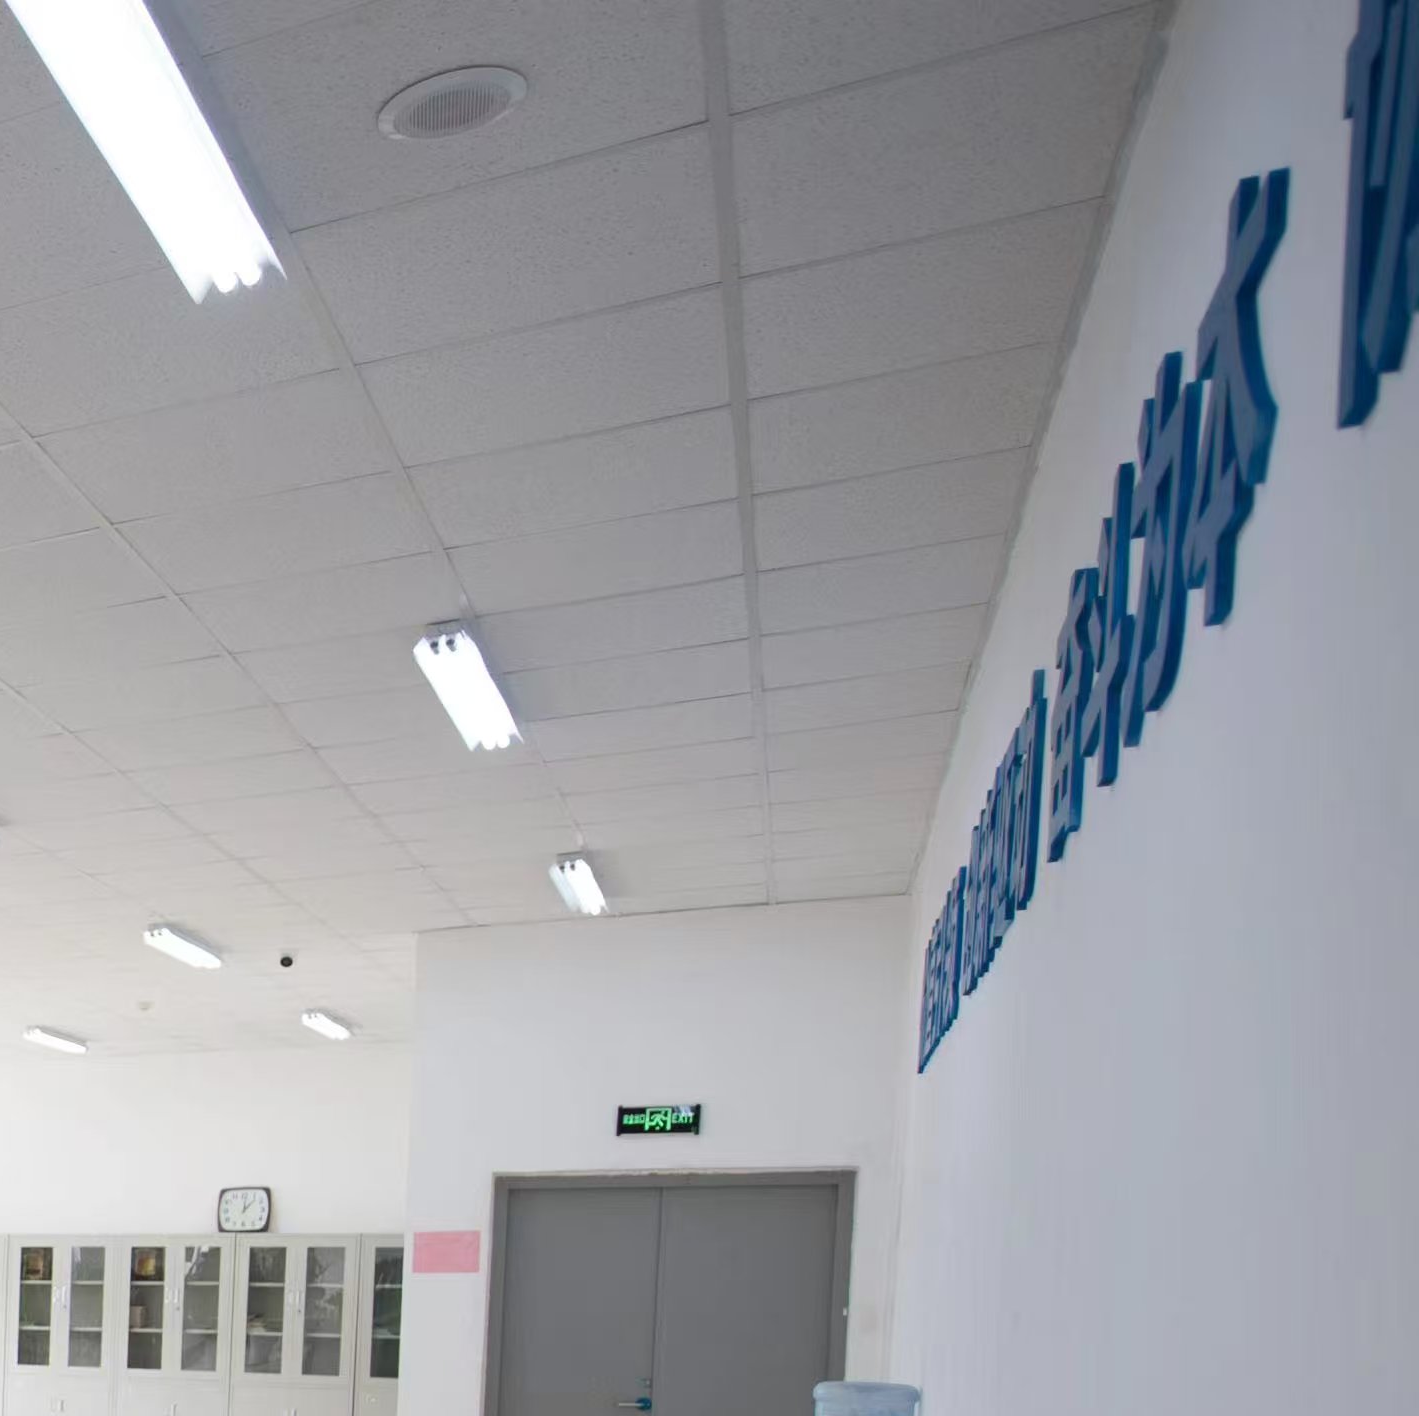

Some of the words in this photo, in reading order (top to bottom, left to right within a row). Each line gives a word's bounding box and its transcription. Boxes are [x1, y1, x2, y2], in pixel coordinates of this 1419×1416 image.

[963, 669, 1047, 996] 创新驱动
[1047, 166, 1290, 862] 奋斗为本
[672, 1112, 694, 1124] EXIT
